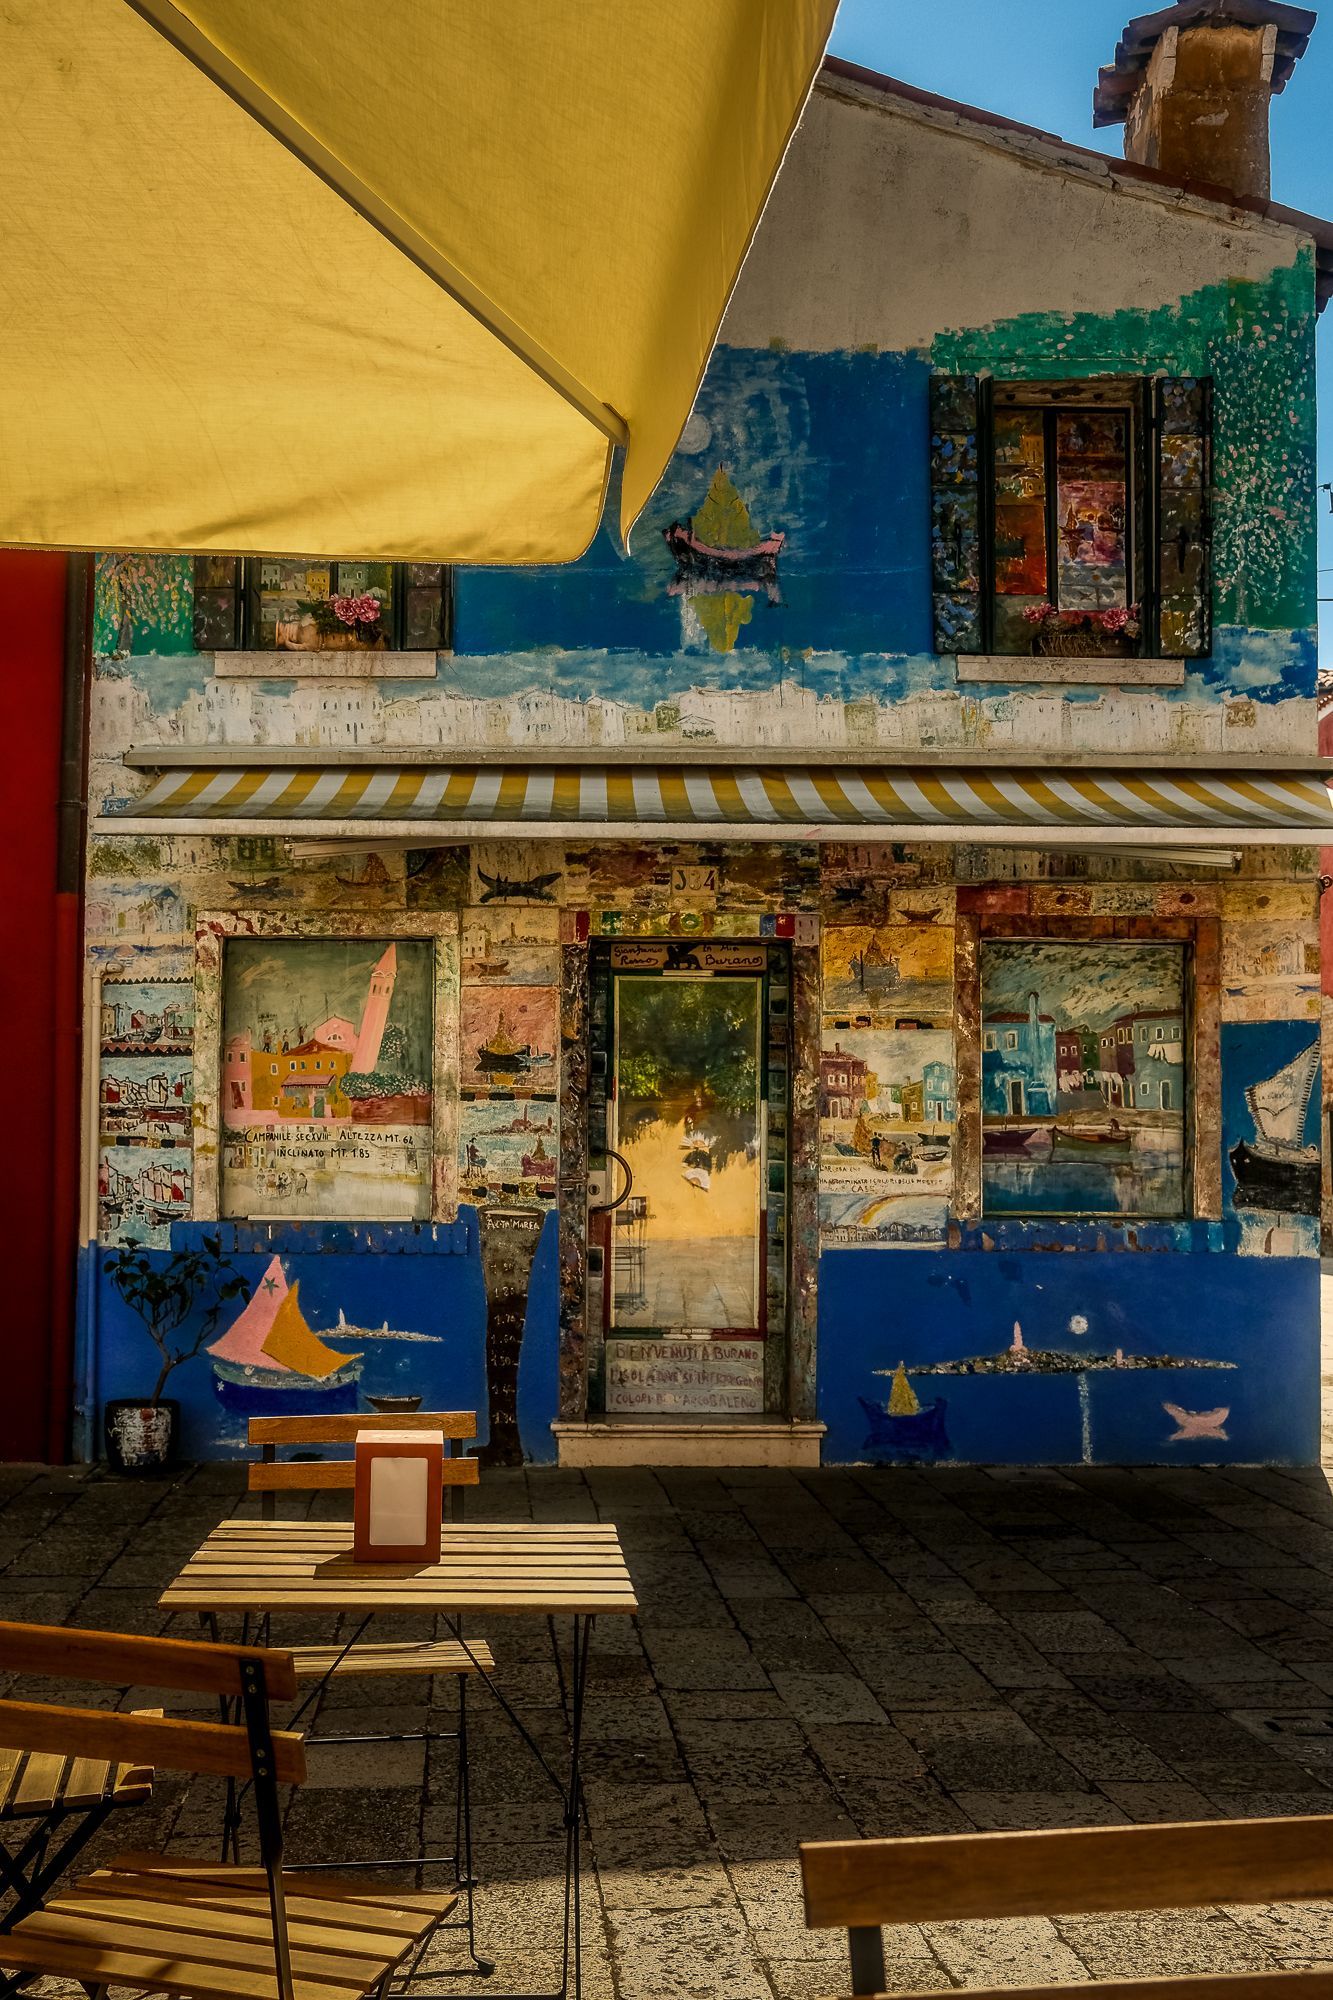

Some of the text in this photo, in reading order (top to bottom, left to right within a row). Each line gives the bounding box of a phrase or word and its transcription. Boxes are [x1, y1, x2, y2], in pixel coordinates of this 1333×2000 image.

[244, 1128, 292, 1143] CAMPANILE
[339, 1129, 383, 1141] ALTEZZA
[402, 1135, 414, 1146] 64
[330, 1147, 348, 1159] MT.
[713, 1346, 759, 1360] BURANO
